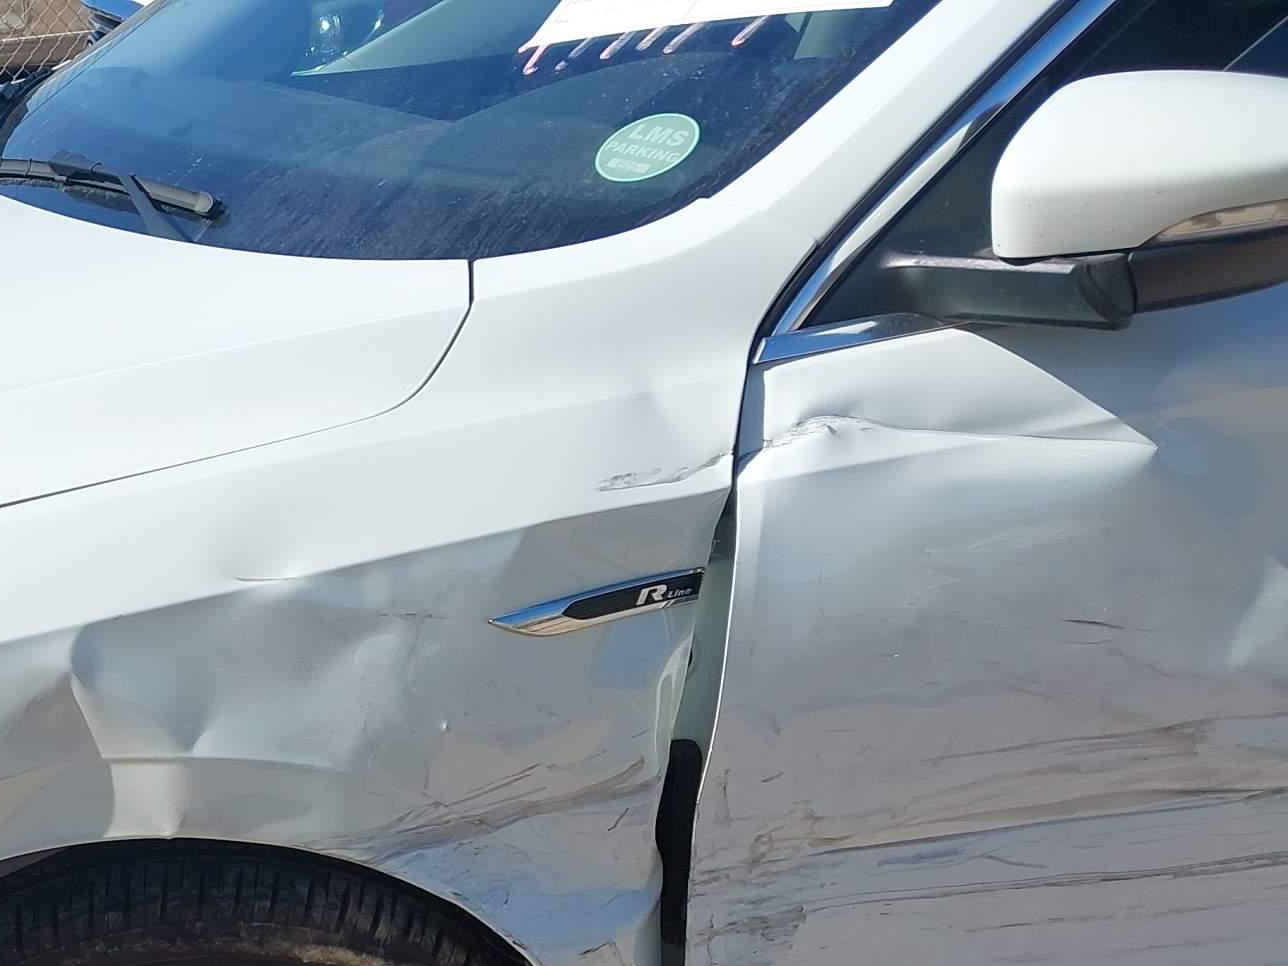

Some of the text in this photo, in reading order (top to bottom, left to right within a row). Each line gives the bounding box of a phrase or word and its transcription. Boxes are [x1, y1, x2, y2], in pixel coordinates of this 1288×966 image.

[628, 124, 689, 147] LMS
[604, 140, 681, 163] PARKING
[637, 584, 667, 605] R
